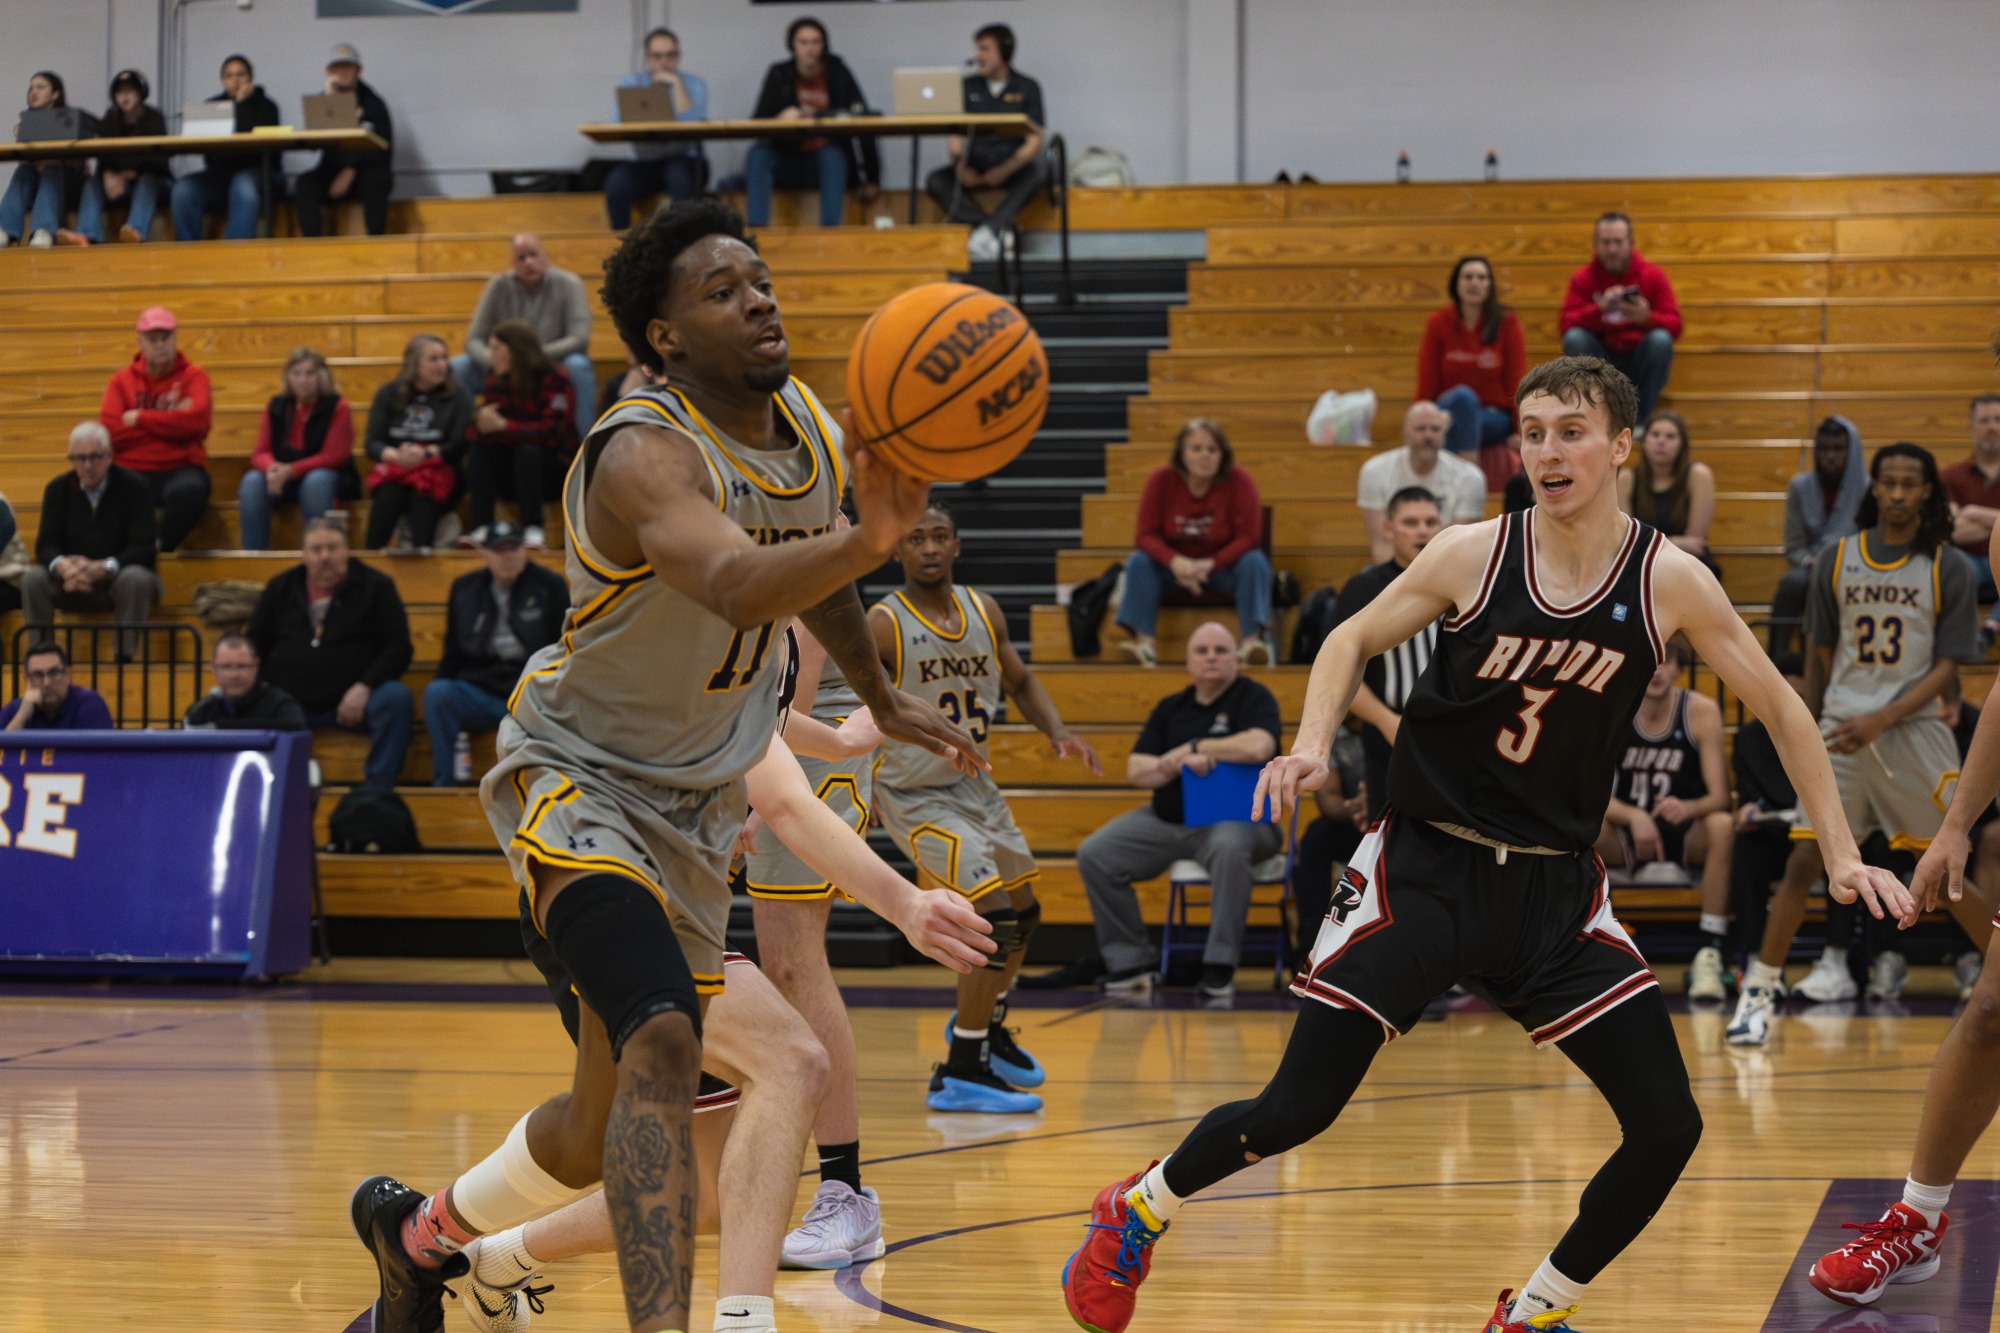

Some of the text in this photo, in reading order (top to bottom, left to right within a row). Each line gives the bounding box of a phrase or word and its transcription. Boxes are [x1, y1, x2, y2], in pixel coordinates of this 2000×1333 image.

[914, 306, 1021, 385] Wilson
[976, 353, 1042, 426] NCAA
[1845, 585, 1920, 608] KNOX
[918, 654, 990, 684] KNOX
[1475, 633, 1626, 695] RIPON
[1855, 613, 1904, 667] 23
[936, 685, 990, 747] 25
[1494, 682, 1559, 766] 3
[0, 772, 84, 859] E
